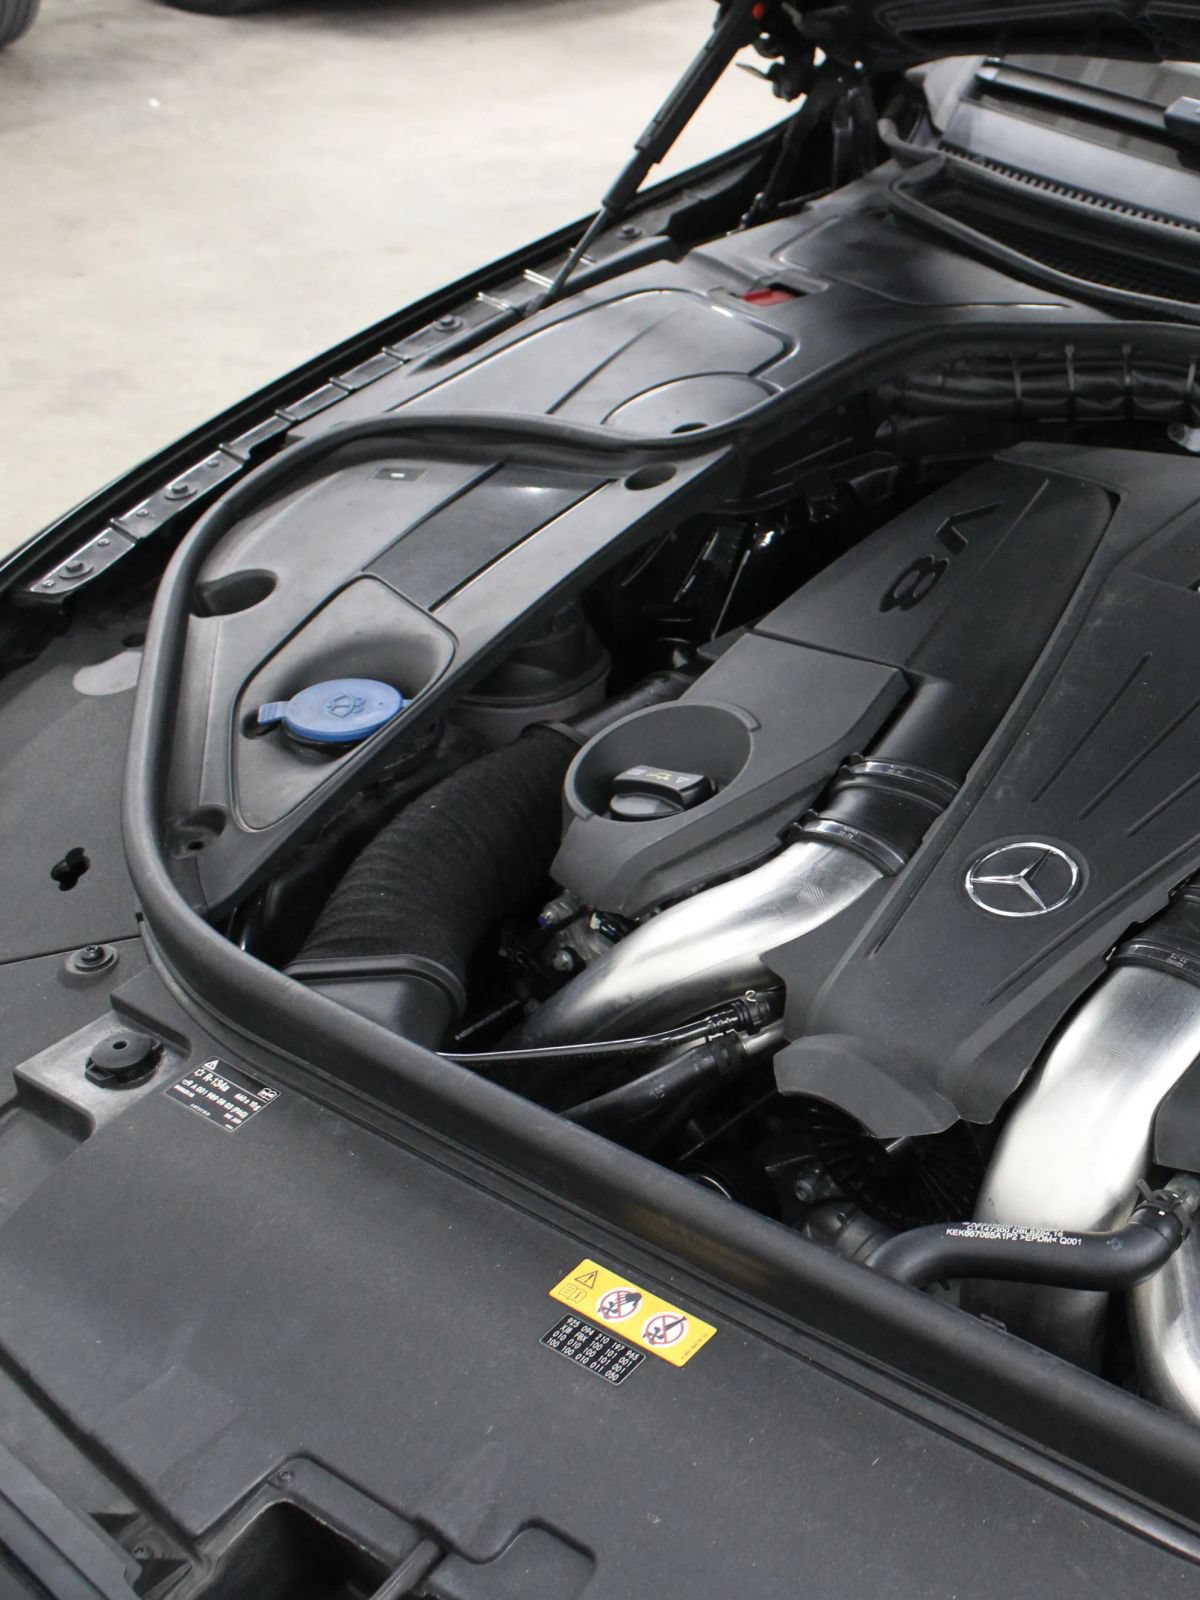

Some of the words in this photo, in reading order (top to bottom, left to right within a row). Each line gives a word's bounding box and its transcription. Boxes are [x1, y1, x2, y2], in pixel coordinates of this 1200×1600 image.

[1059, 1237, 1083, 1246] Q001
[552, 1330, 567, 1341] 010
[567, 1338, 582, 1349] 010
[583, 1347, 596, 1357] 100
[598, 1355, 611, 1366] 101
[611, 1363, 626, 1374] 001
[566, 1317, 581, 1328] 925
[595, 1333, 610, 1344] 210
[611, 1342, 625, 1352] 197
[546, 1337, 560, 1348] 100
[561, 1345, 575, 1356] 100
[575, 1353, 589, 1364] 010
[589, 1361, 604, 1372] 011
[589, 1340, 603, 1351] 100
[604, 1348, 618, 1359] 101
[618, 1356, 632, 1367] 001
